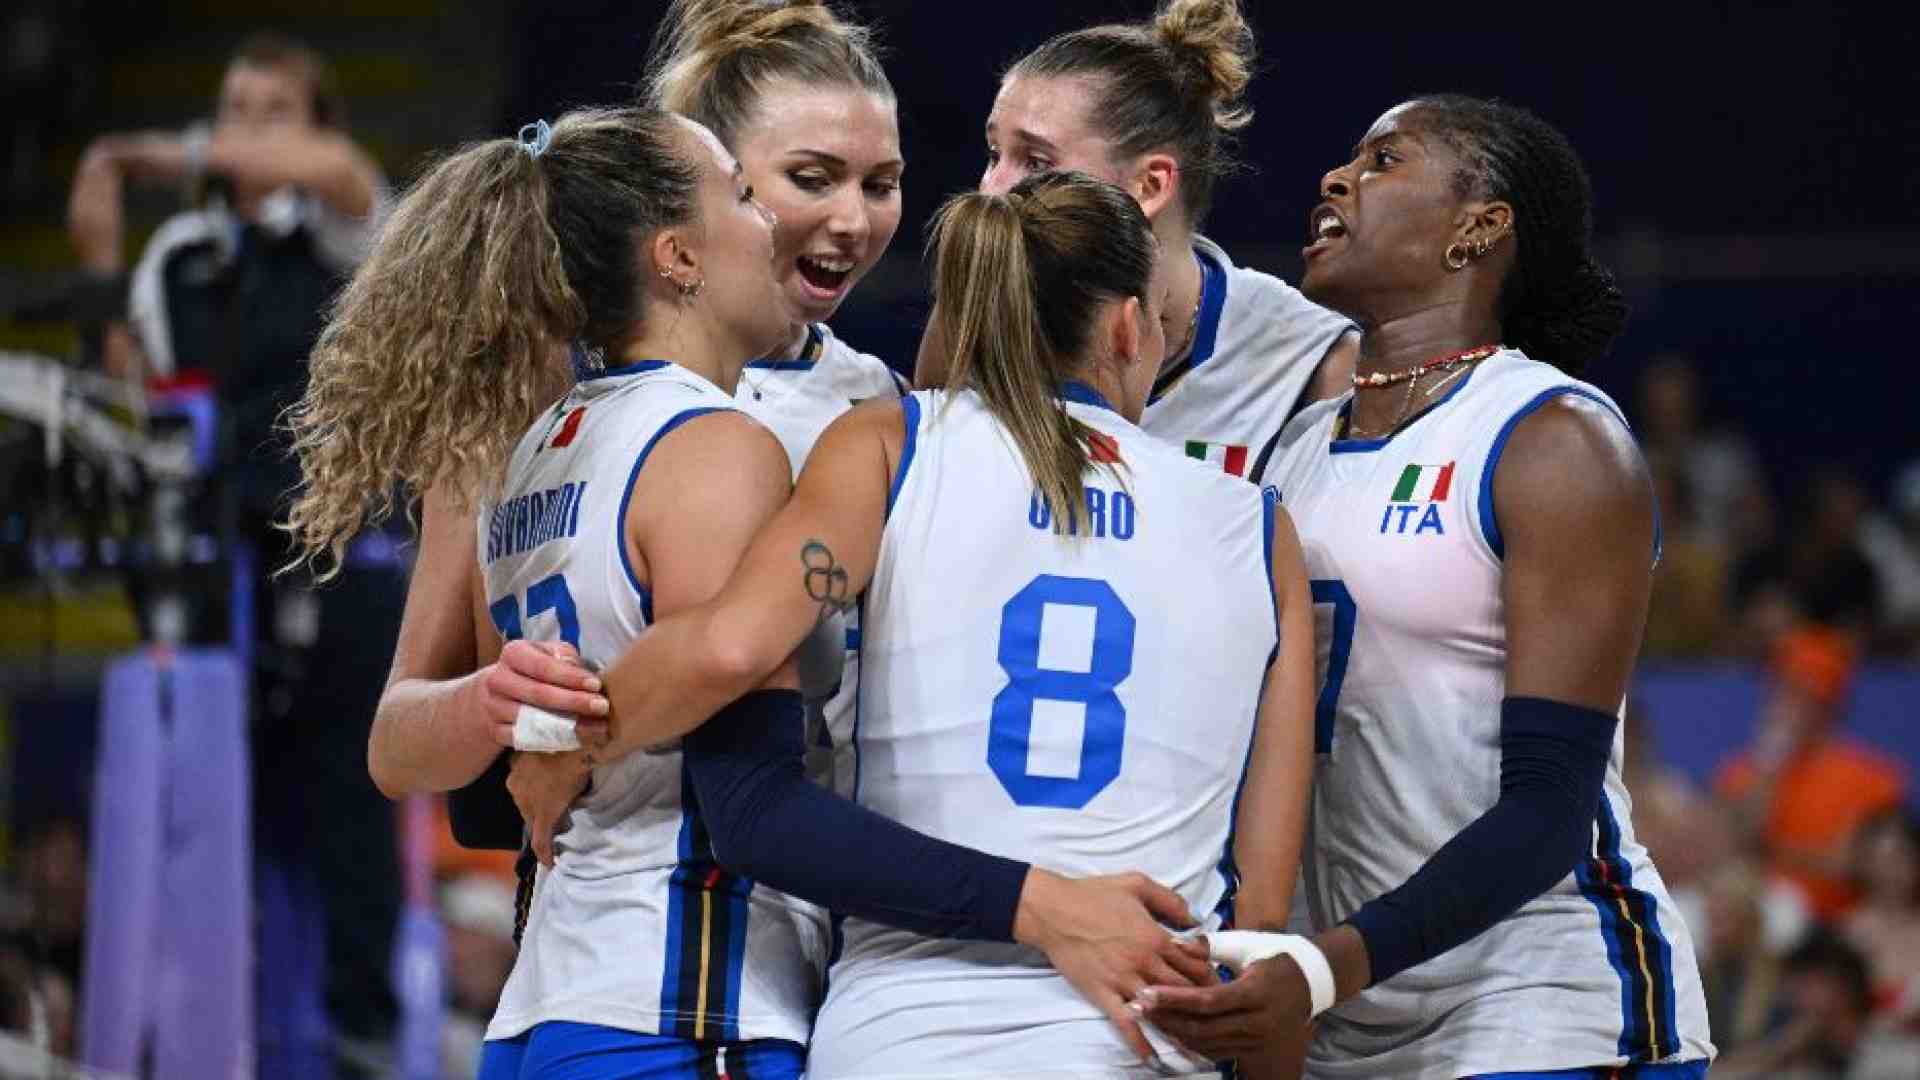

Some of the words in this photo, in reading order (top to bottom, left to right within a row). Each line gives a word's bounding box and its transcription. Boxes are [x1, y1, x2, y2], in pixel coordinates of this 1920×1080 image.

[1028, 487, 1135, 539] ORO
[1380, 503, 1444, 534] ITA
[987, 573, 1137, 810] 8
